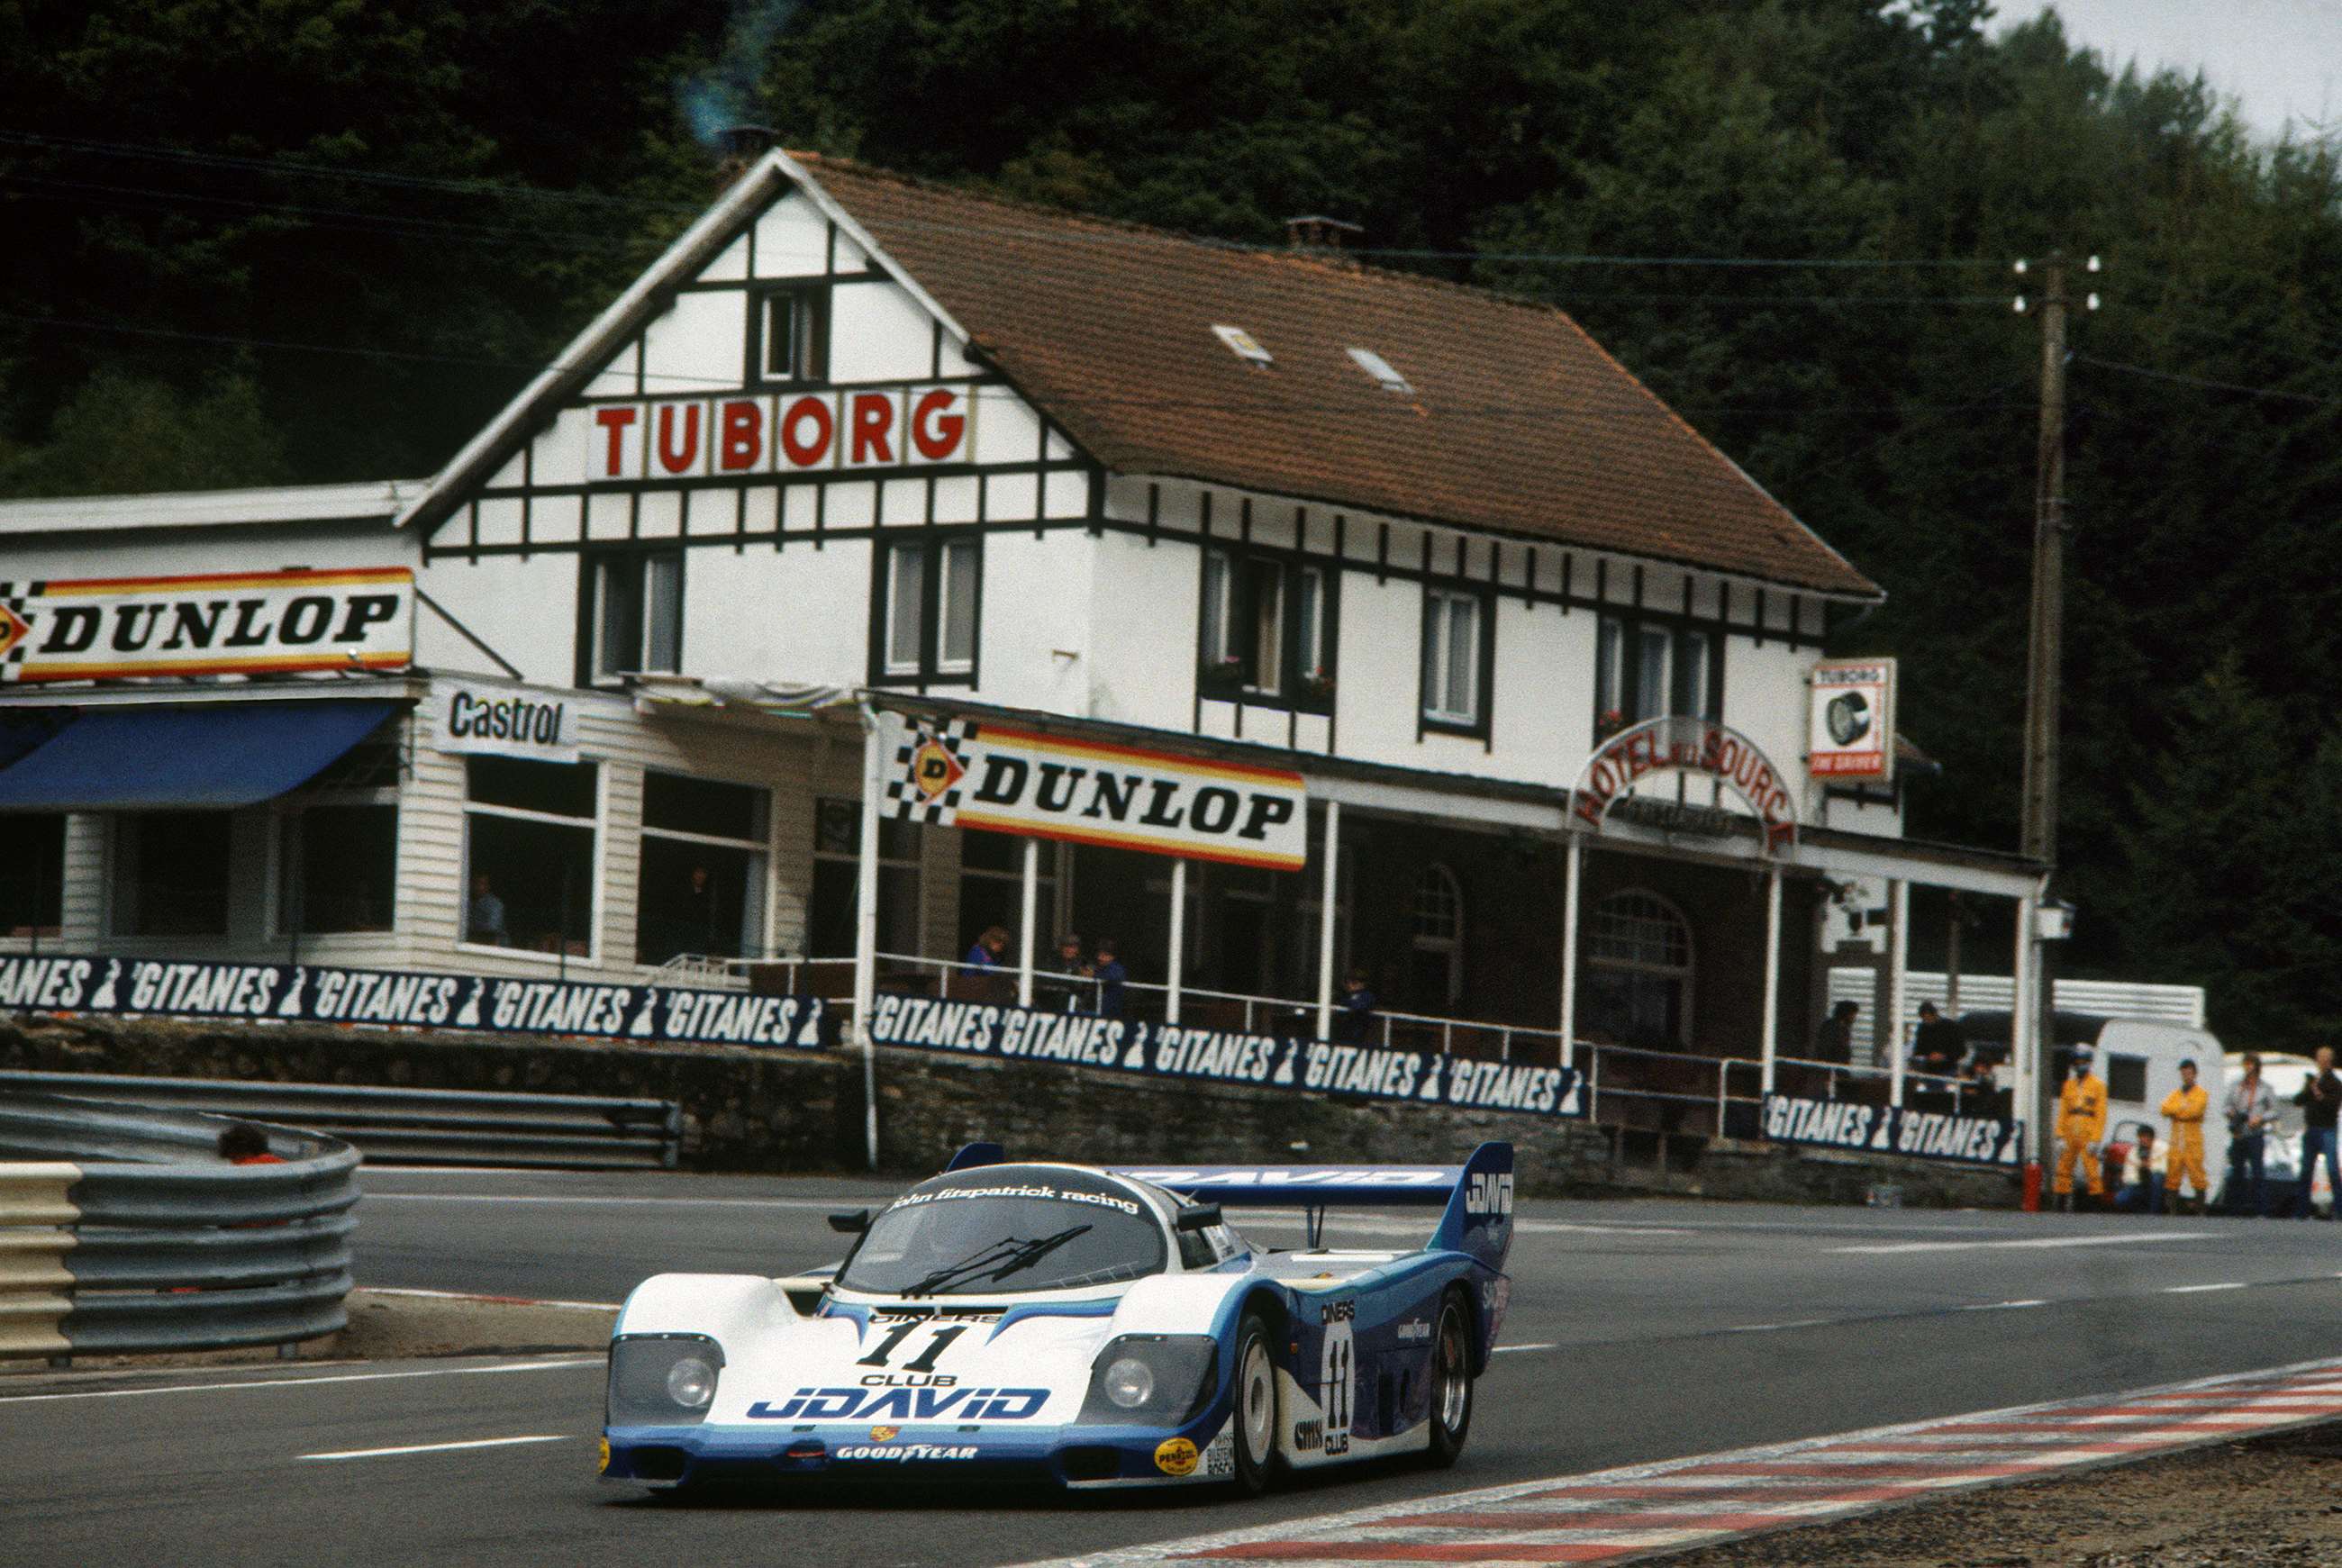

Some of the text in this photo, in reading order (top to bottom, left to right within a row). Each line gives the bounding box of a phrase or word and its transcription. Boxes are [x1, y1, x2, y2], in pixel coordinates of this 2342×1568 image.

[596, 389, 965, 476] TUBORG
[39, 594, 401, 655] DUNLOP
[450, 691, 563, 745] Castrol
[974, 754, 1295, 840] DUNLOP
[1575, 729, 1794, 852] HOTEL SOURCE
[130, 962, 281, 1015] GITANES
[314, 971, 458, 1024] GITANES
[492, 981, 630, 1035] GITANES
[665, 991, 798, 1045] GITANES
[873, 994, 1562, 1112] GITANES GITANES GITANES GITANES GITANES
[1767, 1096, 2002, 1162] GITANES GITANES
[934, 1184, 1056, 1201] fitzpatrick
[1061, 1190, 1139, 1215] racing
[856, 1321, 969, 1373] 11
[859, 1374, 959, 1387] CLUB
[1328, 1338, 1349, 1429] 11
[836, 1444, 979, 1464] GOODYEAR
[1325, 1433, 1349, 1456] CLUB
